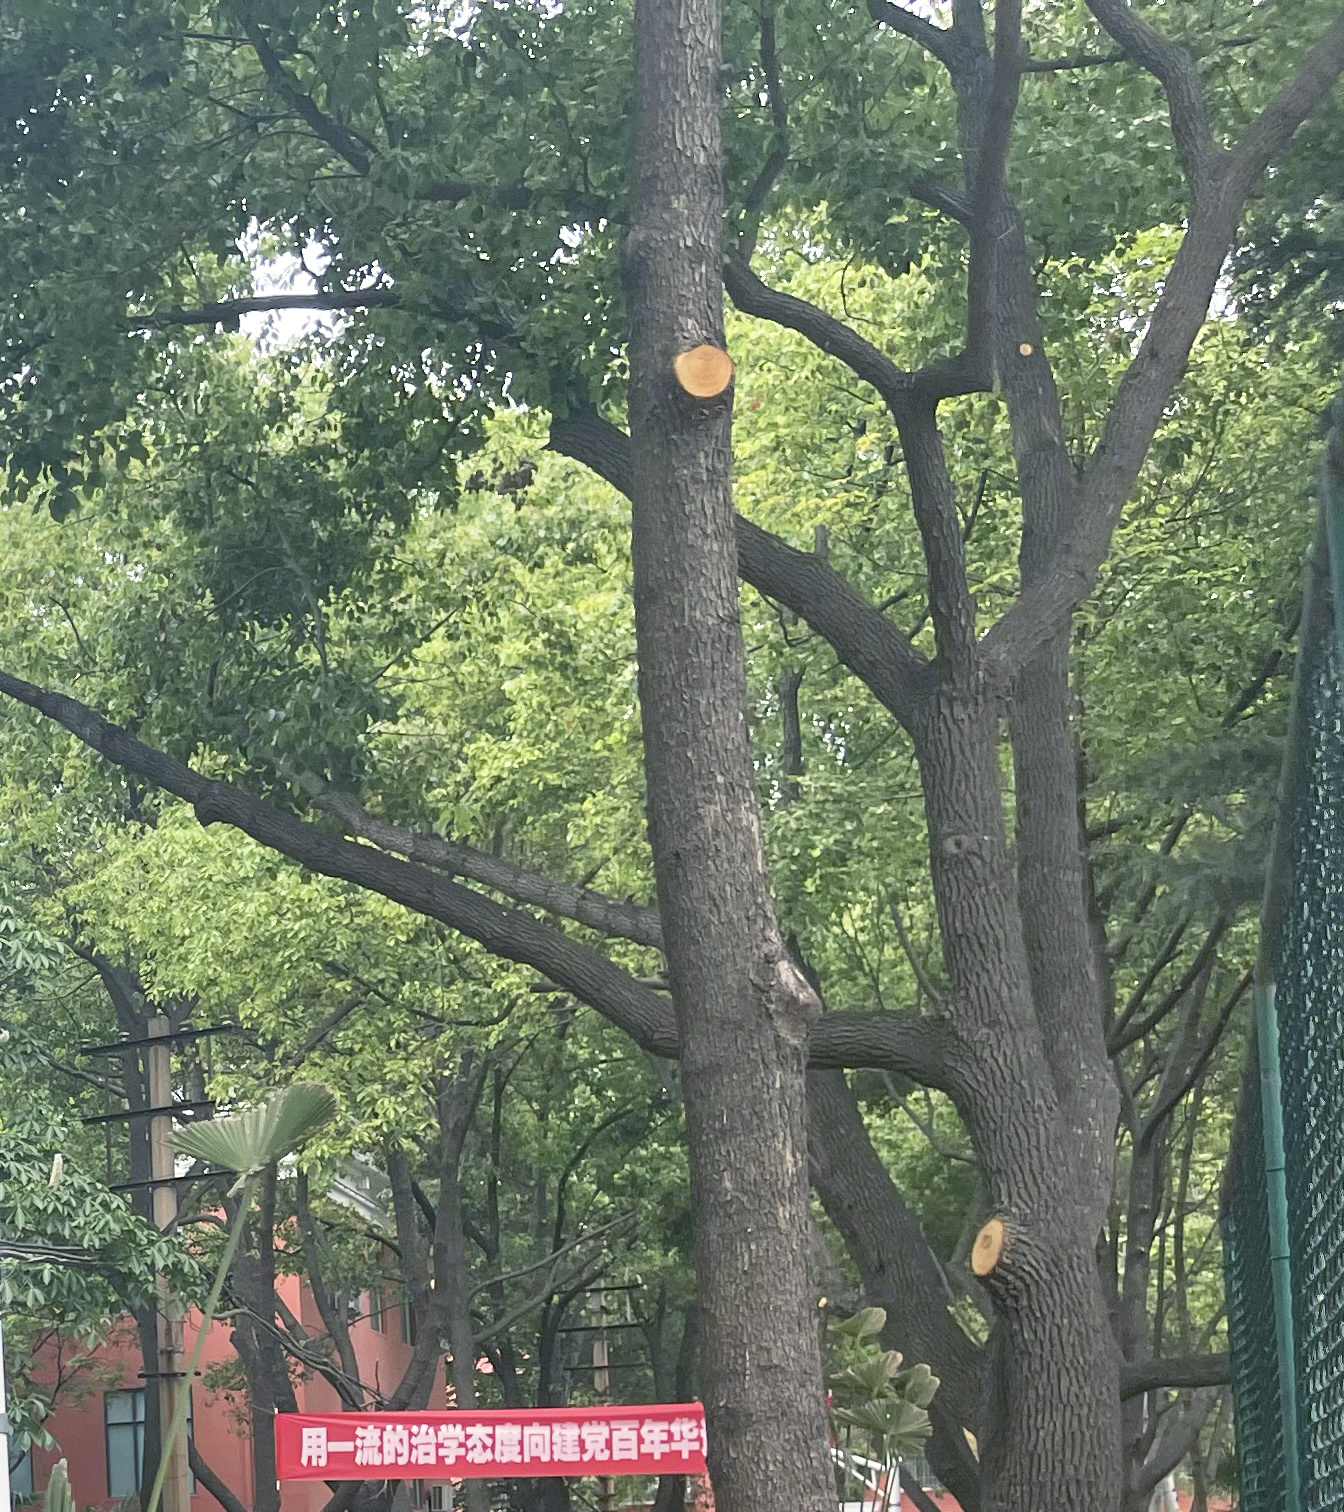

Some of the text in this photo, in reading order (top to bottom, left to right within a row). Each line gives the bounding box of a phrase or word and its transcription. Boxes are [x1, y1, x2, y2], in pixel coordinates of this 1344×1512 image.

[301, 1417, 708, 1468] 用一流的治学态度向建党百年华
